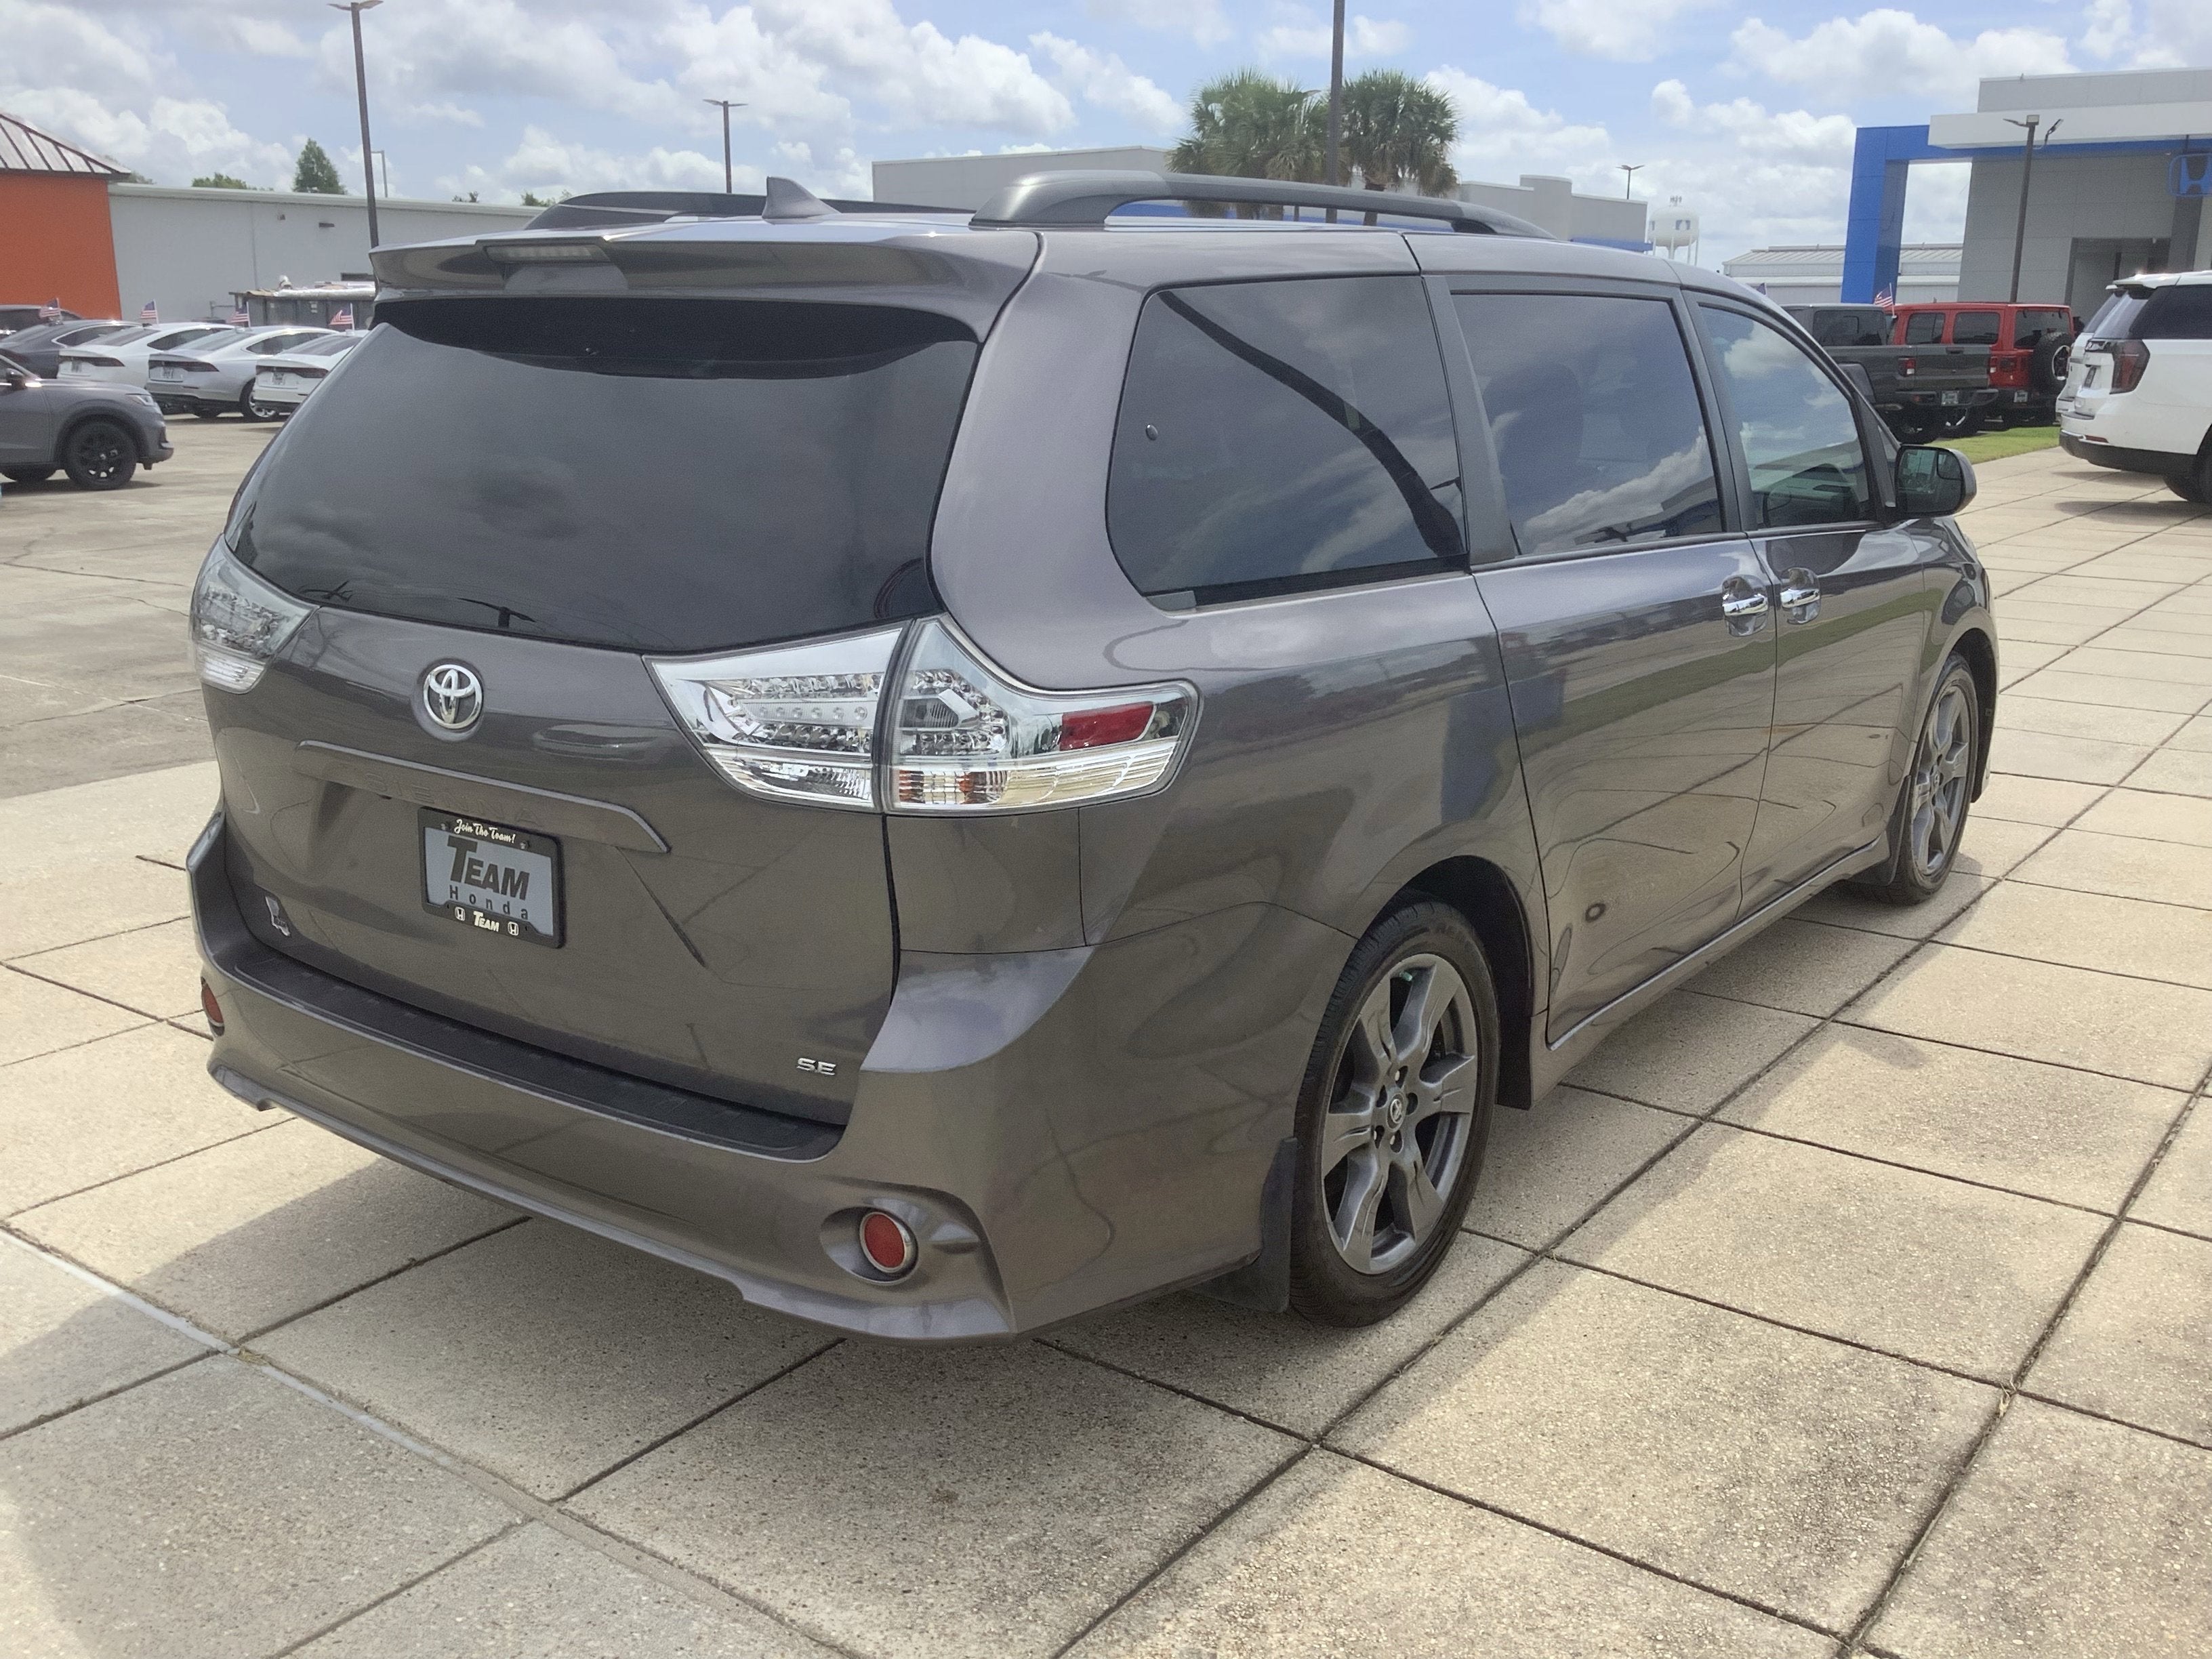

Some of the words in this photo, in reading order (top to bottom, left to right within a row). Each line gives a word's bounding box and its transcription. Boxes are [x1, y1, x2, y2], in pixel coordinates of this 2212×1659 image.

[364, 772, 541, 827] SIENNA
[454, 819, 474, 834] Join
[447, 835, 530, 901] TEAM
[449, 884, 529, 920] Honda
[473, 911, 500, 933] TEAM
[796, 1058, 836, 1076] SE
